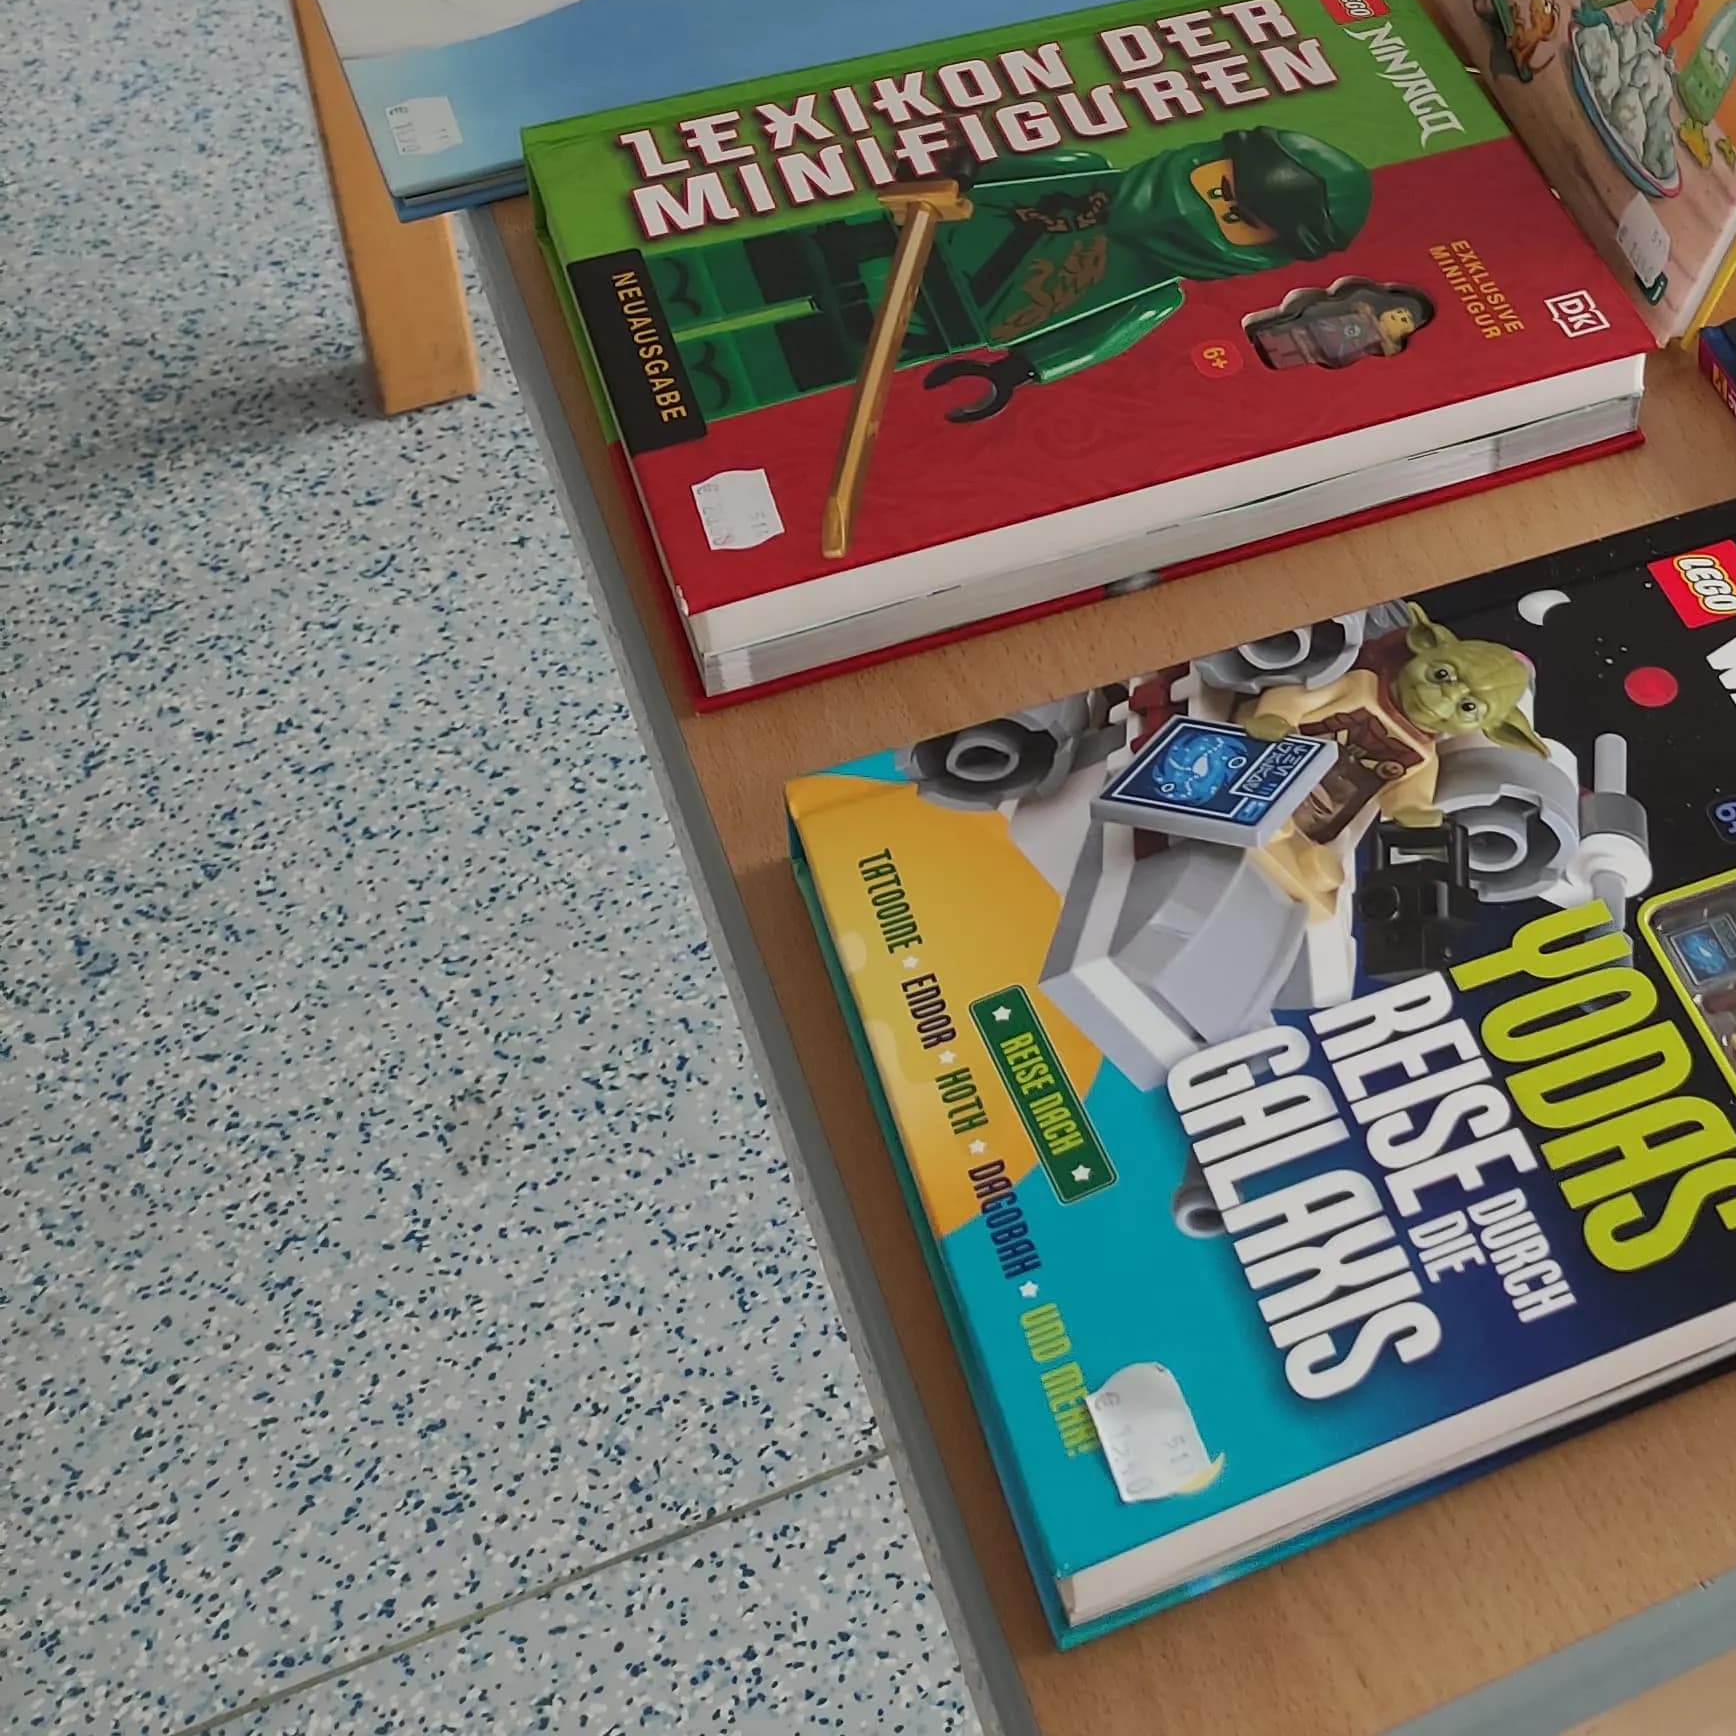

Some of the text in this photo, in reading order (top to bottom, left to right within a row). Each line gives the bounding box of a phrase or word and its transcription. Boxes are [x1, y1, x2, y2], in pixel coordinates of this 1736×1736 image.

[617, 42, 1075, 178] LEXIKON
[631, 36, 1339, 240] MINIFIGUREN
[1343, 21, 1466, 150] NINJAGO
[611, 270, 688, 423] NEUAUSGABE
[1429, 244, 1503, 340] MINIFIGUR
[1450, 239, 1525, 334] EXKLUSIVE
[1558, 299, 1596, 331] DK
[1201, 345, 1230, 370] 6+
[858, 848, 923, 954] TATOOINE
[901, 972, 958, 1050] ENDOR
[935, 1066, 989, 1136] HOTH
[967, 1158, 1042, 1280] DAGOBAH
[1020, 1302, 1072, 1363] UND
[1000, 1031, 1085, 1156] REISE NACH
[1309, 970, 1579, 1323] REISE DURCH
[1167, 1024, 1444, 1401] GALAXIS
[1407, 1208, 1485, 1283] DIE
